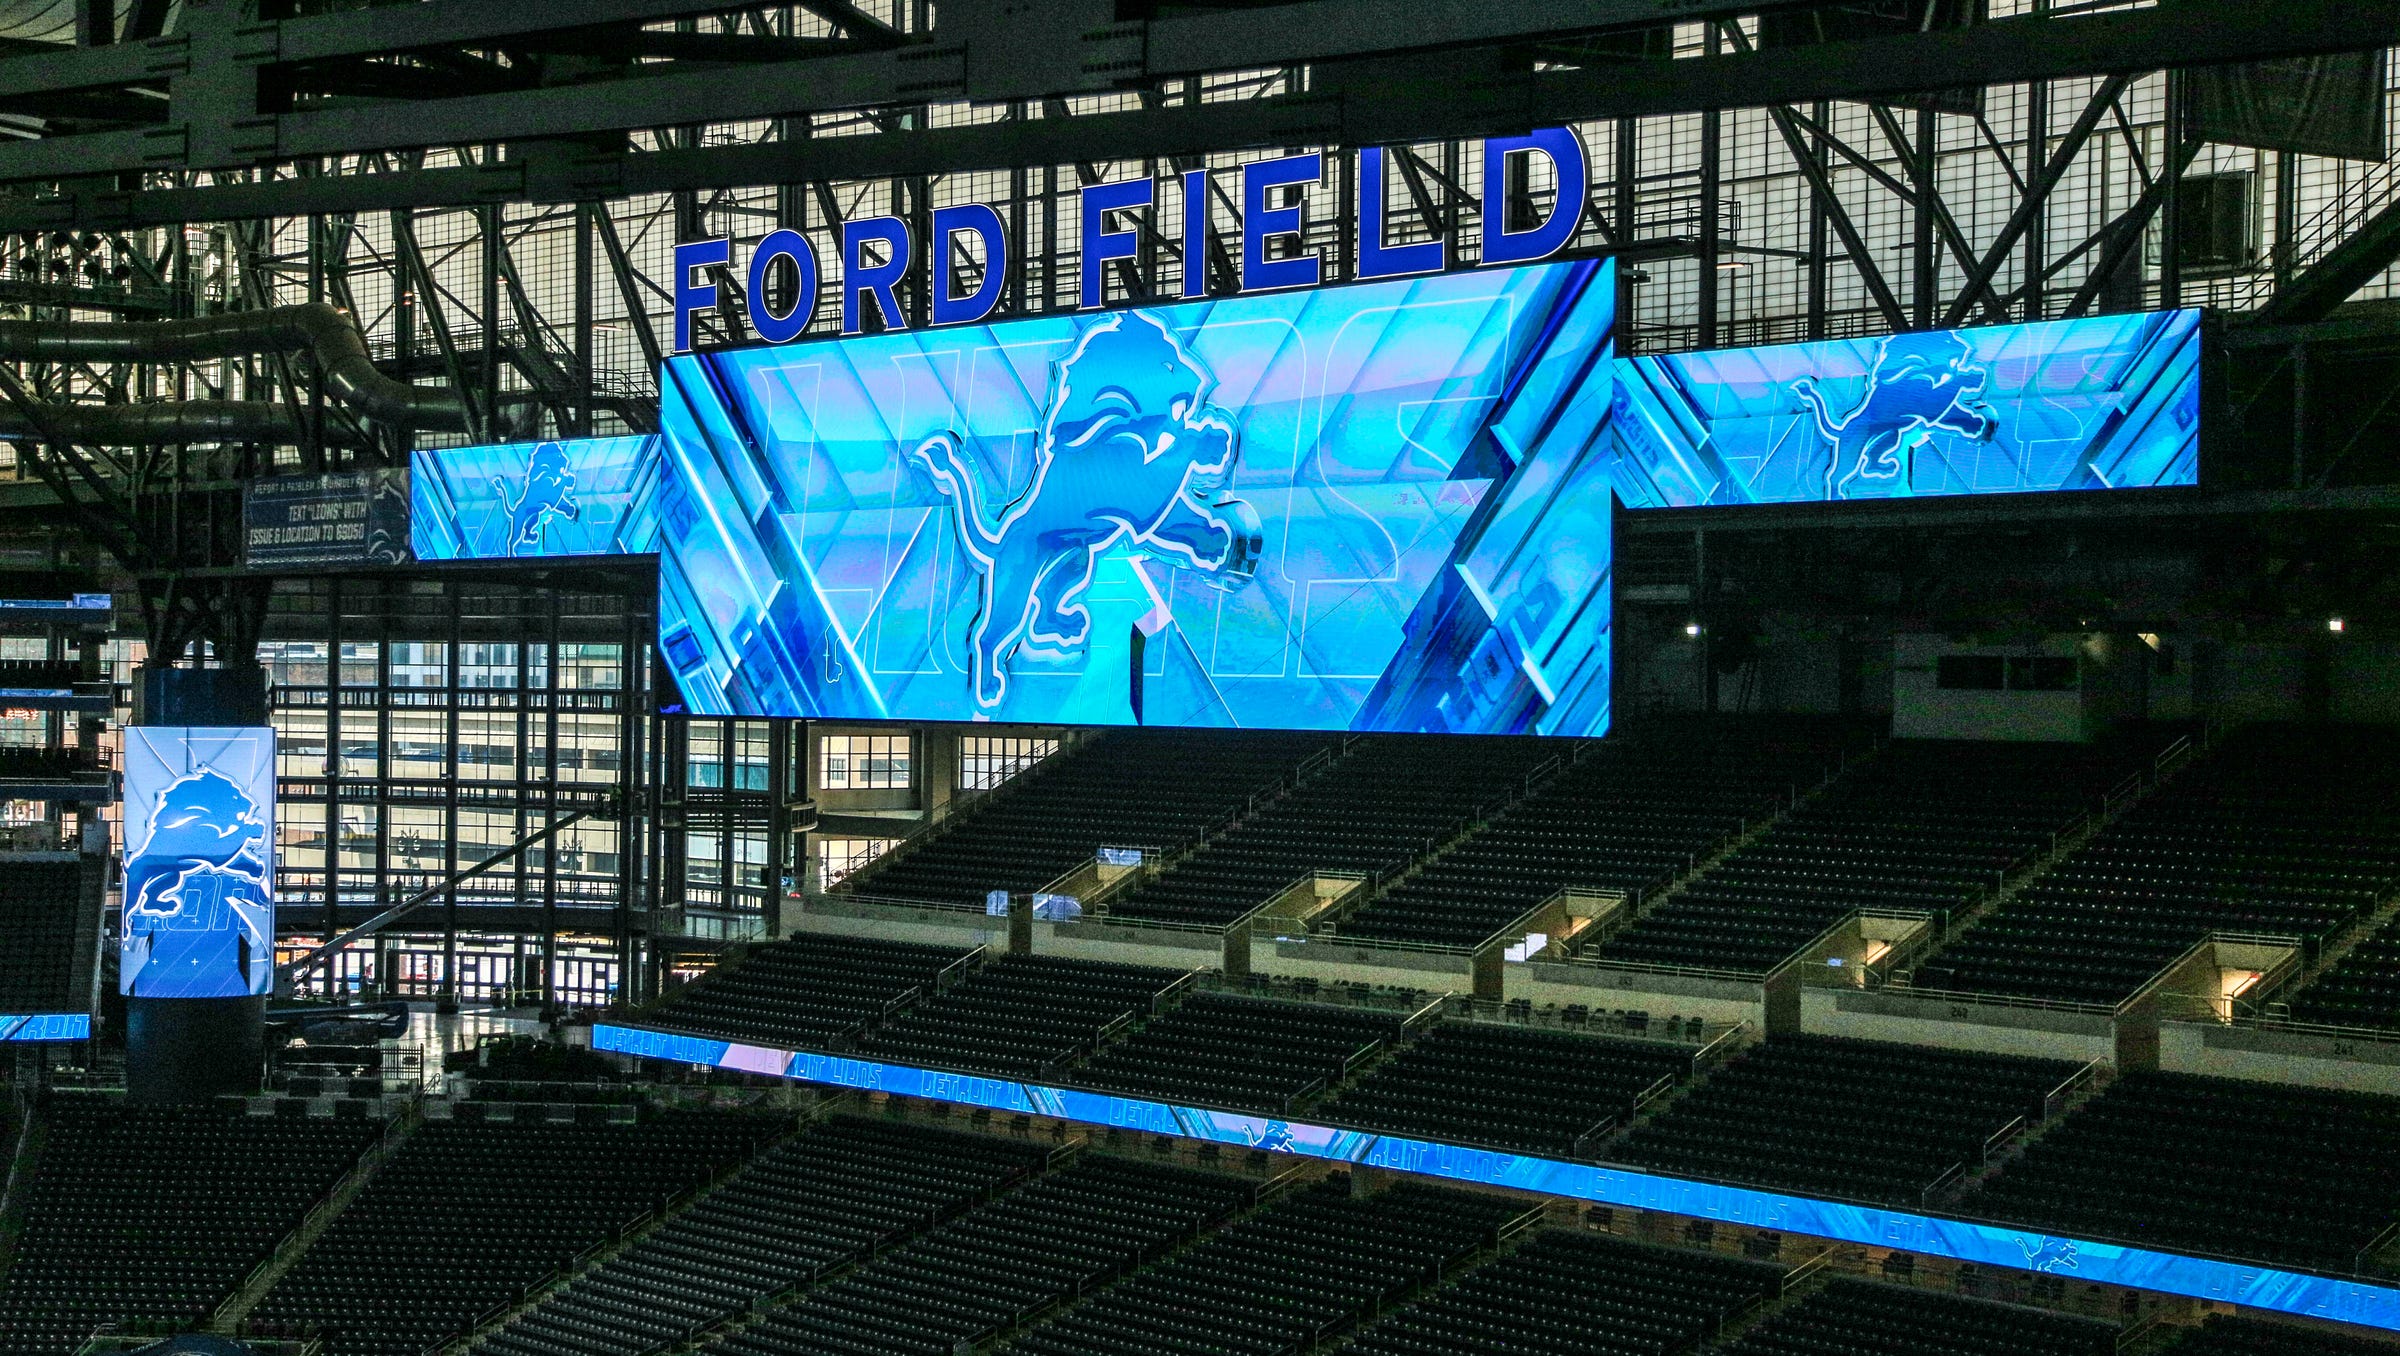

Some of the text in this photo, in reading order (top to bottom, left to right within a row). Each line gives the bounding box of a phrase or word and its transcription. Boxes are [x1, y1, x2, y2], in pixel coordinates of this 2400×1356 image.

[671, 123, 1590, 354] FORD FIELD
[288, 504, 306, 522] TEXT
[344, 501, 367, 519] WITH
[249, 526, 272, 545] ISSUE
[281, 525, 320, 544] LOCATION
[322, 524, 334, 542] TO
[921, 1069, 1002, 1107] DETROIT
